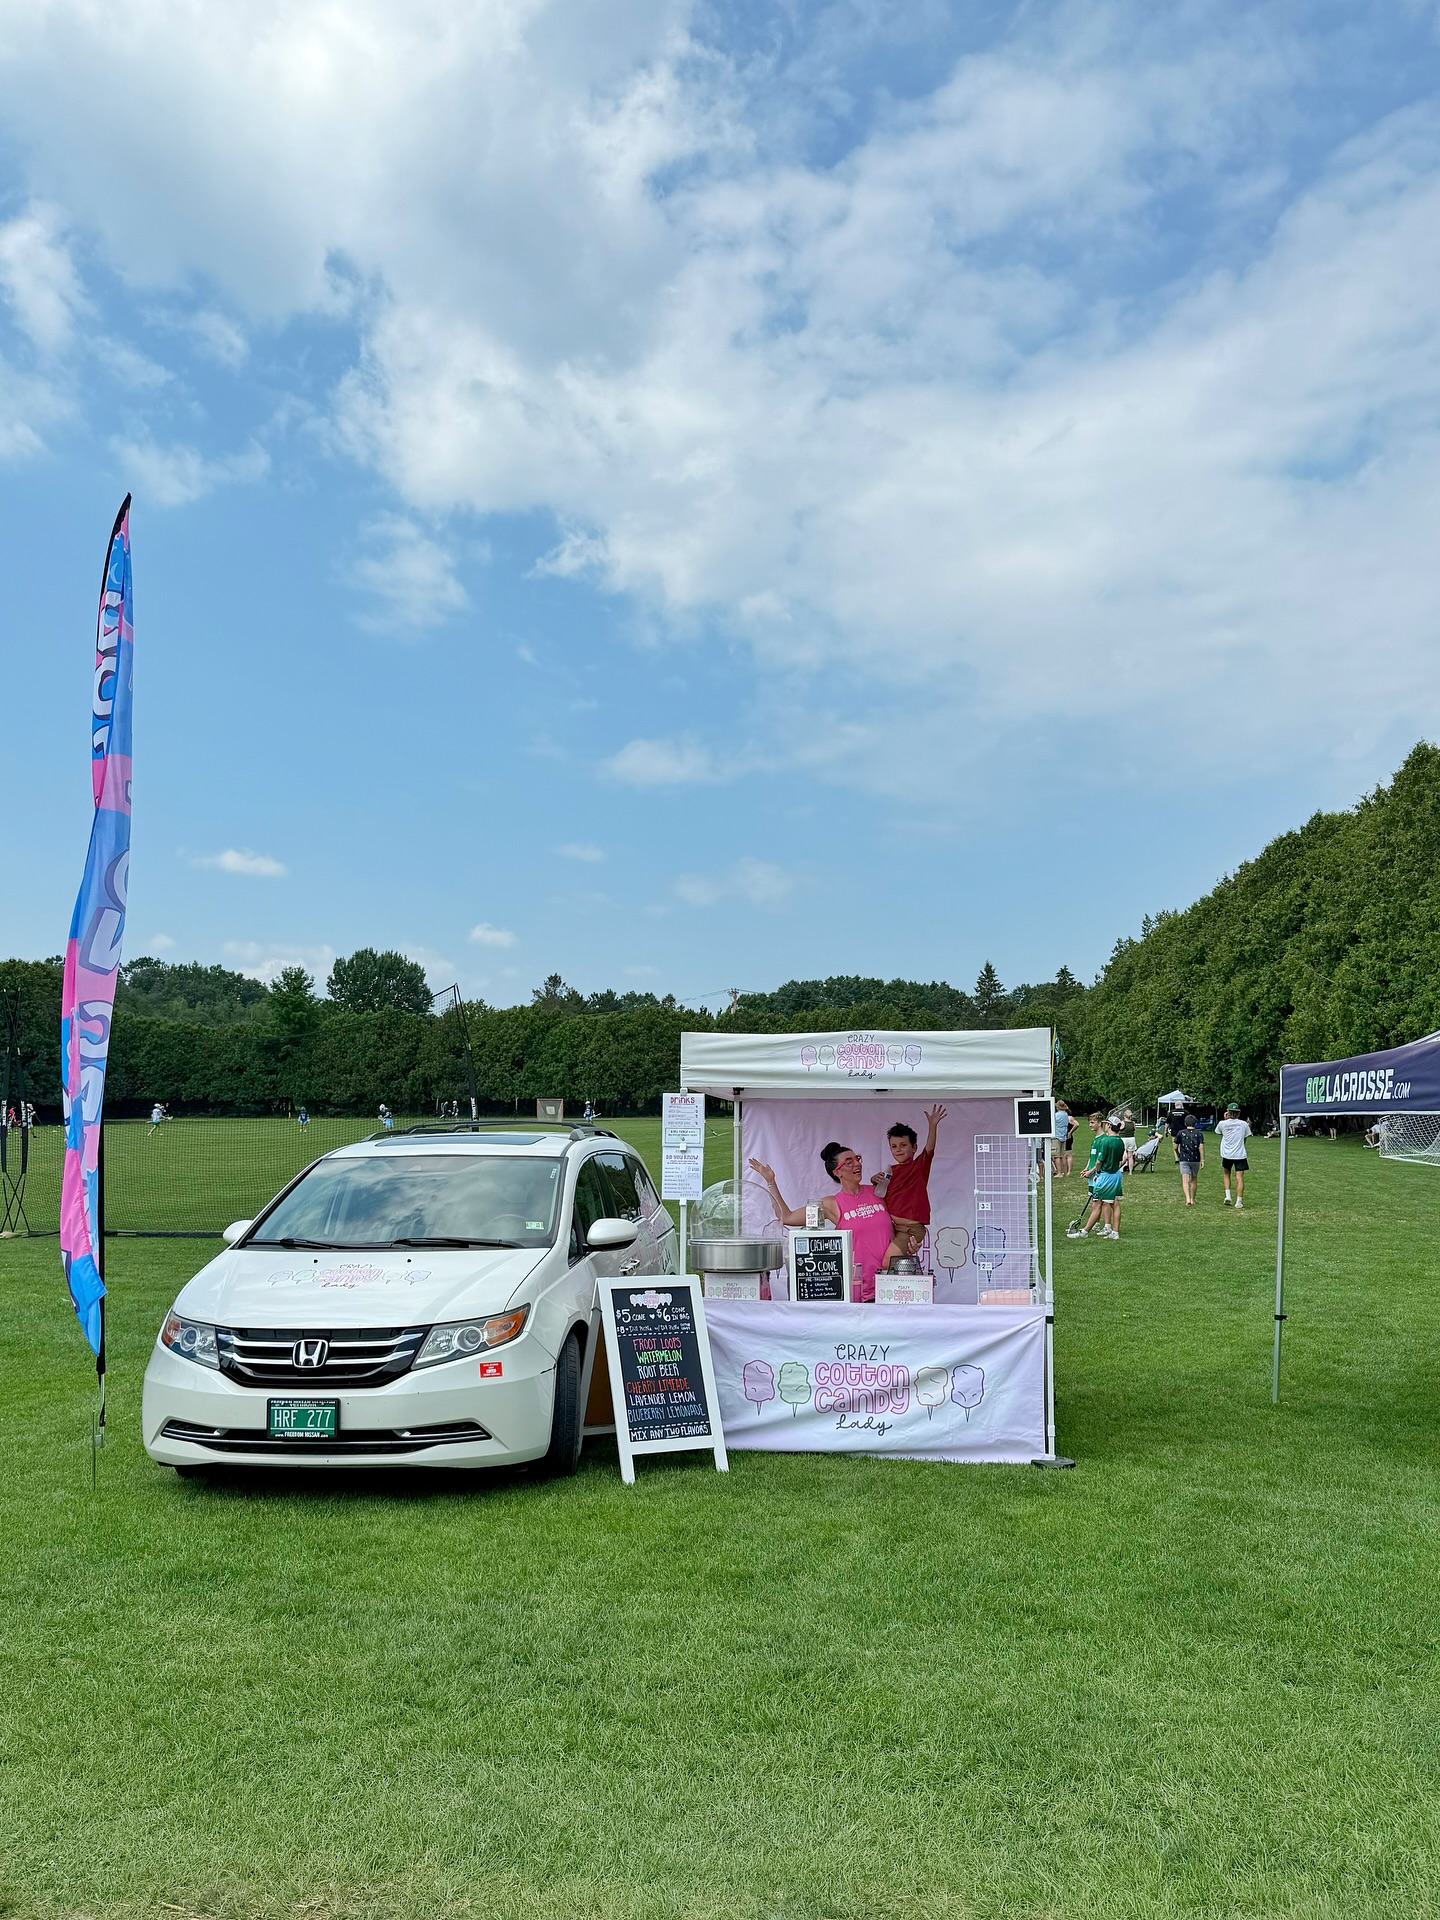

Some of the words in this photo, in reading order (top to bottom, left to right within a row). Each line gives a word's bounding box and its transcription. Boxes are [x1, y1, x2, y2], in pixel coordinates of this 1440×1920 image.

[847, 1034, 875, 1043] CRAZY
[837, 1043, 885, 1056] cotton
[1306, 1069, 1411, 1103] 802LACROSSE.COM
[817, 1261, 839, 1272] CONE
[616, 1308, 632, 1323] $5
[632, 1313, 647, 1321] CONE
[656, 1307, 671, 1322] $6
[632, 1338, 657, 1351] FROOT
[660, 1337, 682, 1350] LOOPS
[636, 1349, 683, 1364] WATERMELON
[834, 1344, 890, 1361] CRAZY
[637, 1364, 657, 1379] ROOT
[659, 1363, 679, 1377] BEER
[815, 1362, 910, 1387] cotton
[626, 1380, 656, 1394] CHERRY
[658, 1377, 690, 1392] LIMEADE
[629, 1392, 666, 1406] LAVENDER
[669, 1391, 696, 1404] LEMON
[274, 1410, 298, 1427] HRF
[307, 1410, 331, 1427] 277
[627, 1406, 666, 1423] BLUEBERRY
[667, 1403, 706, 1418] LEMONADE
[630, 1430, 647, 1441] MIX
[650, 1429, 663, 1439] ANY
[664, 1427, 680, 1437] TWO
[681, 1424, 709, 1435] FLAVORS
[836, 1414, 892, 1436] Lady
